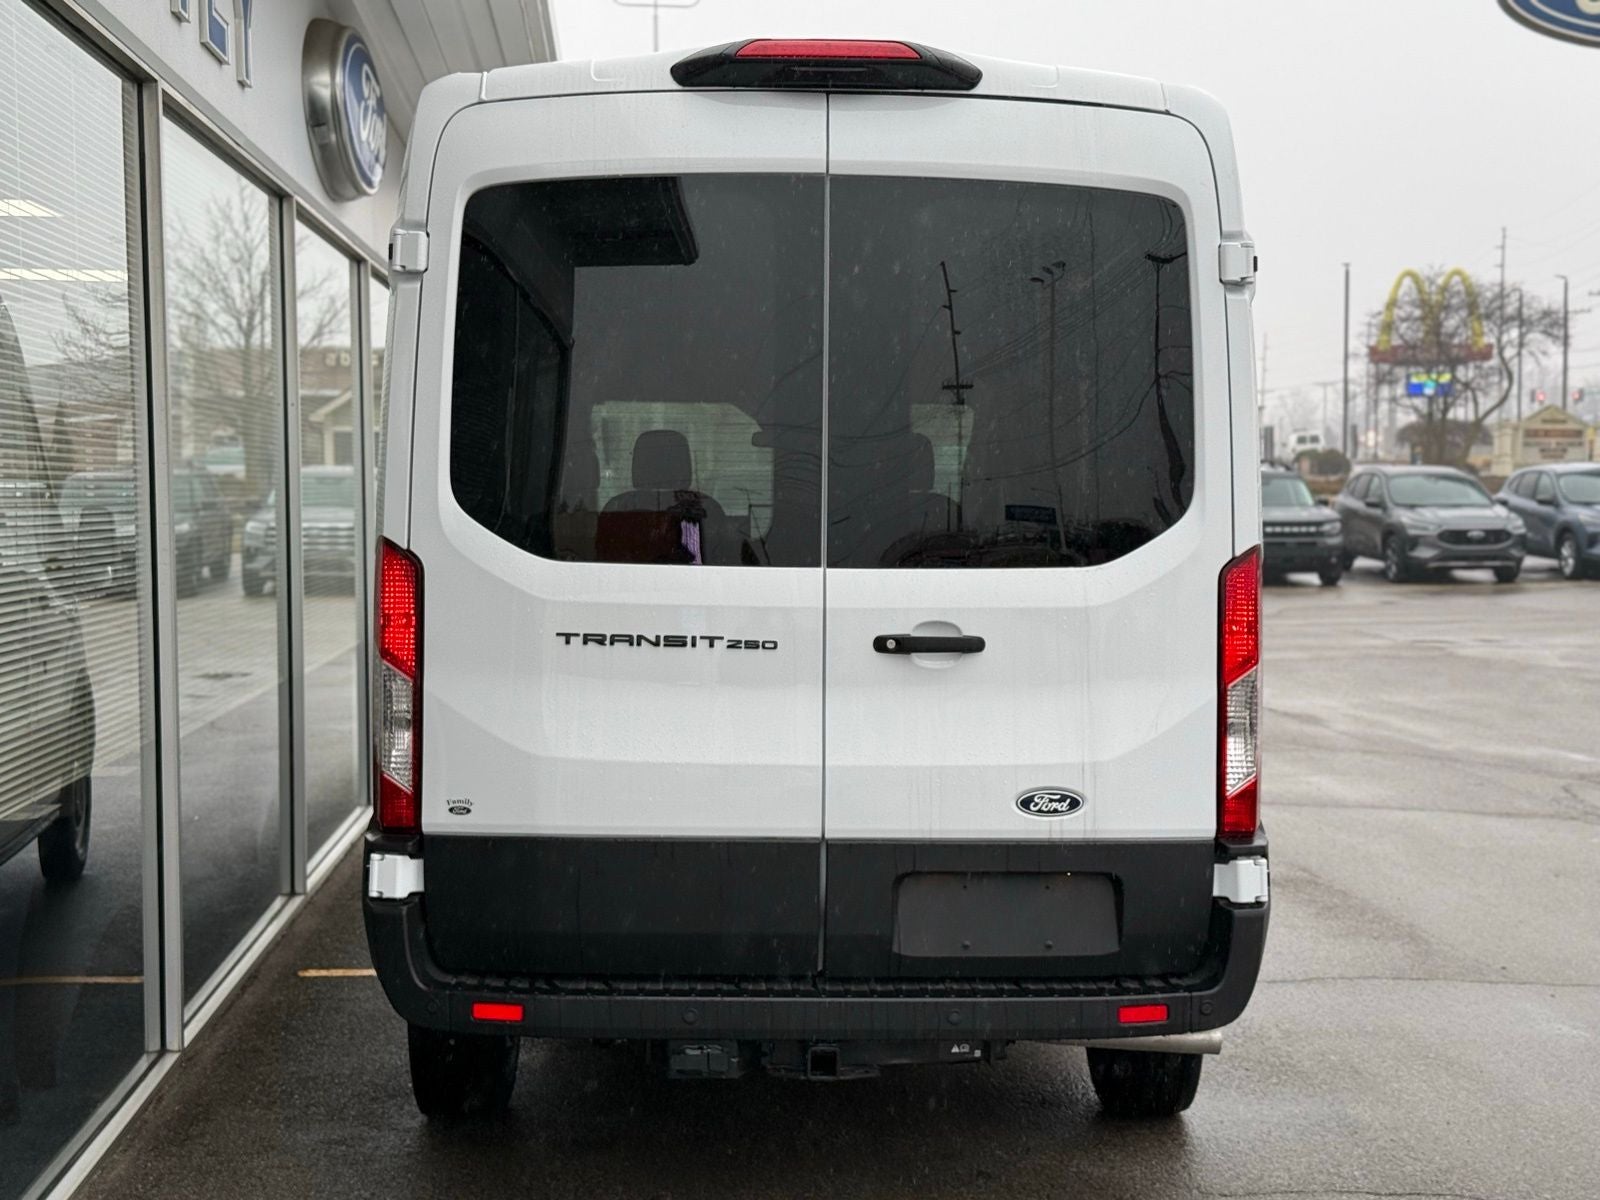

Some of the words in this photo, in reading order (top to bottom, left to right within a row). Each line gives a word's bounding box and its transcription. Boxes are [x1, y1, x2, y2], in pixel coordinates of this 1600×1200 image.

[555, 632, 724, 649] TRANSIT
[726, 639, 778, 650] 250
[446, 798, 474, 806] Family
[1029, 794, 1071, 811] Ford
